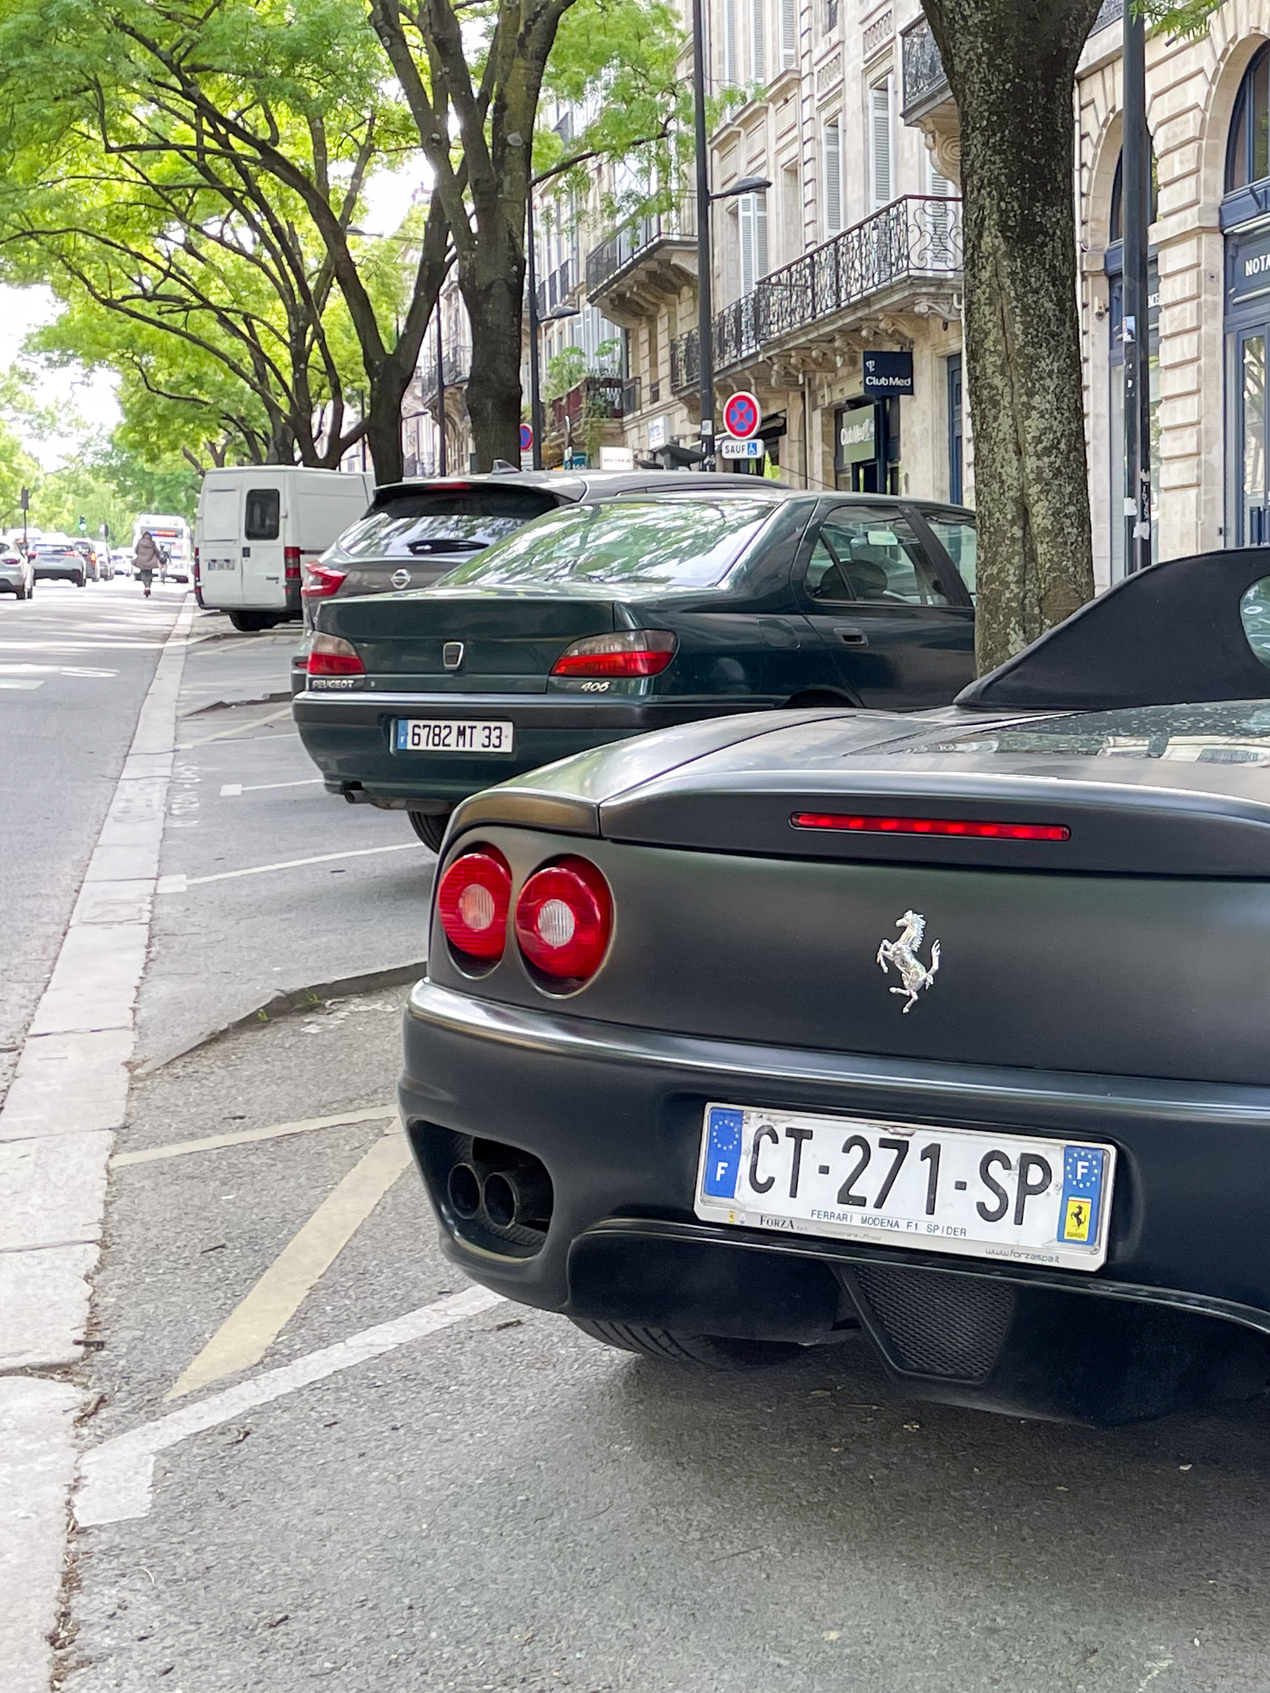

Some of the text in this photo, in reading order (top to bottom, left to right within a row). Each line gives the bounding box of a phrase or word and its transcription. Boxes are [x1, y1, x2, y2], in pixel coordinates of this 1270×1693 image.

[865, 375, 912, 387] Club Med
[724, 444, 747, 454] SAUF
[312, 680, 355, 690] PEUGEOT
[580, 680, 611, 693] 406
[411, 724, 503, 749] 6782 MT 33
[715, 1161, 728, 1182] F
[748, 1124, 1053, 1226] CT-271-SP
[1076, 1160, 1090, 1180] F
[811, 1208, 967, 1238] FERRARI MODENA F1 SPIDER
